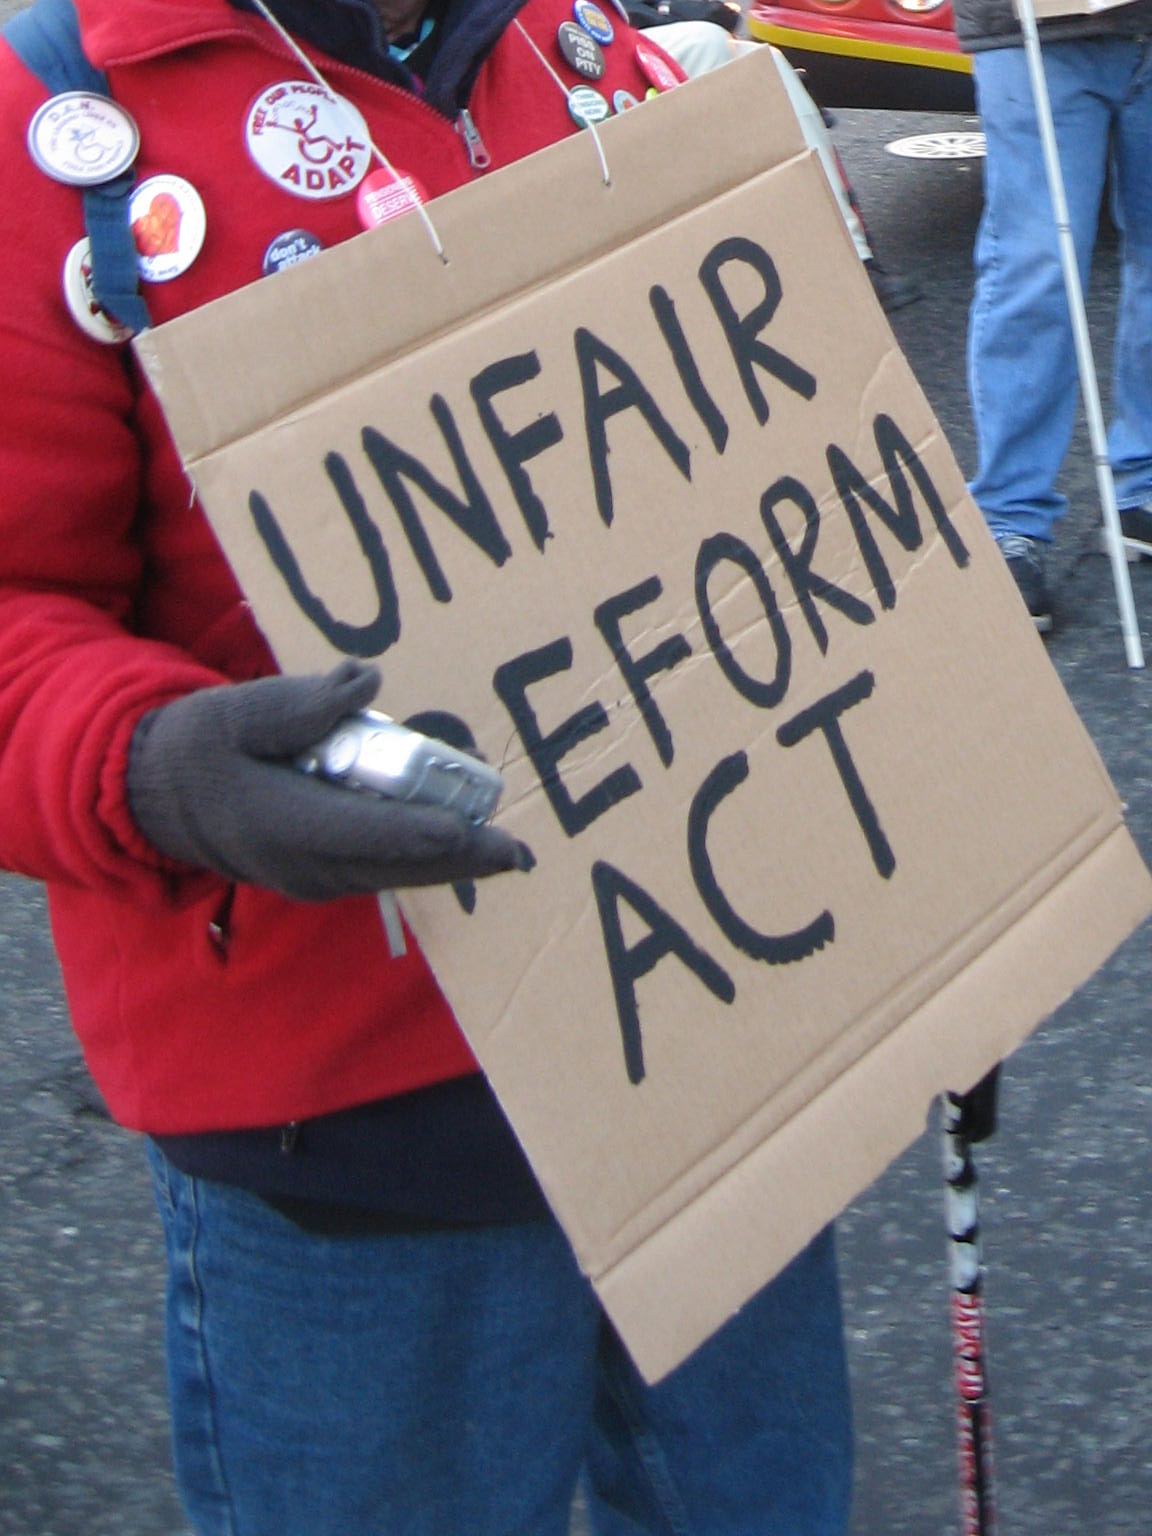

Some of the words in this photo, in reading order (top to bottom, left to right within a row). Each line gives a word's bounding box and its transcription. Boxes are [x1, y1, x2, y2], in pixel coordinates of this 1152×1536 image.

[575, 56, 602, 76] PITY
[281, 135, 366, 191] ADAPT
[270, 237, 307, 262] don't
[248, 236, 818, 658] UNFAIR
[591, 670, 898, 1085] ACT
